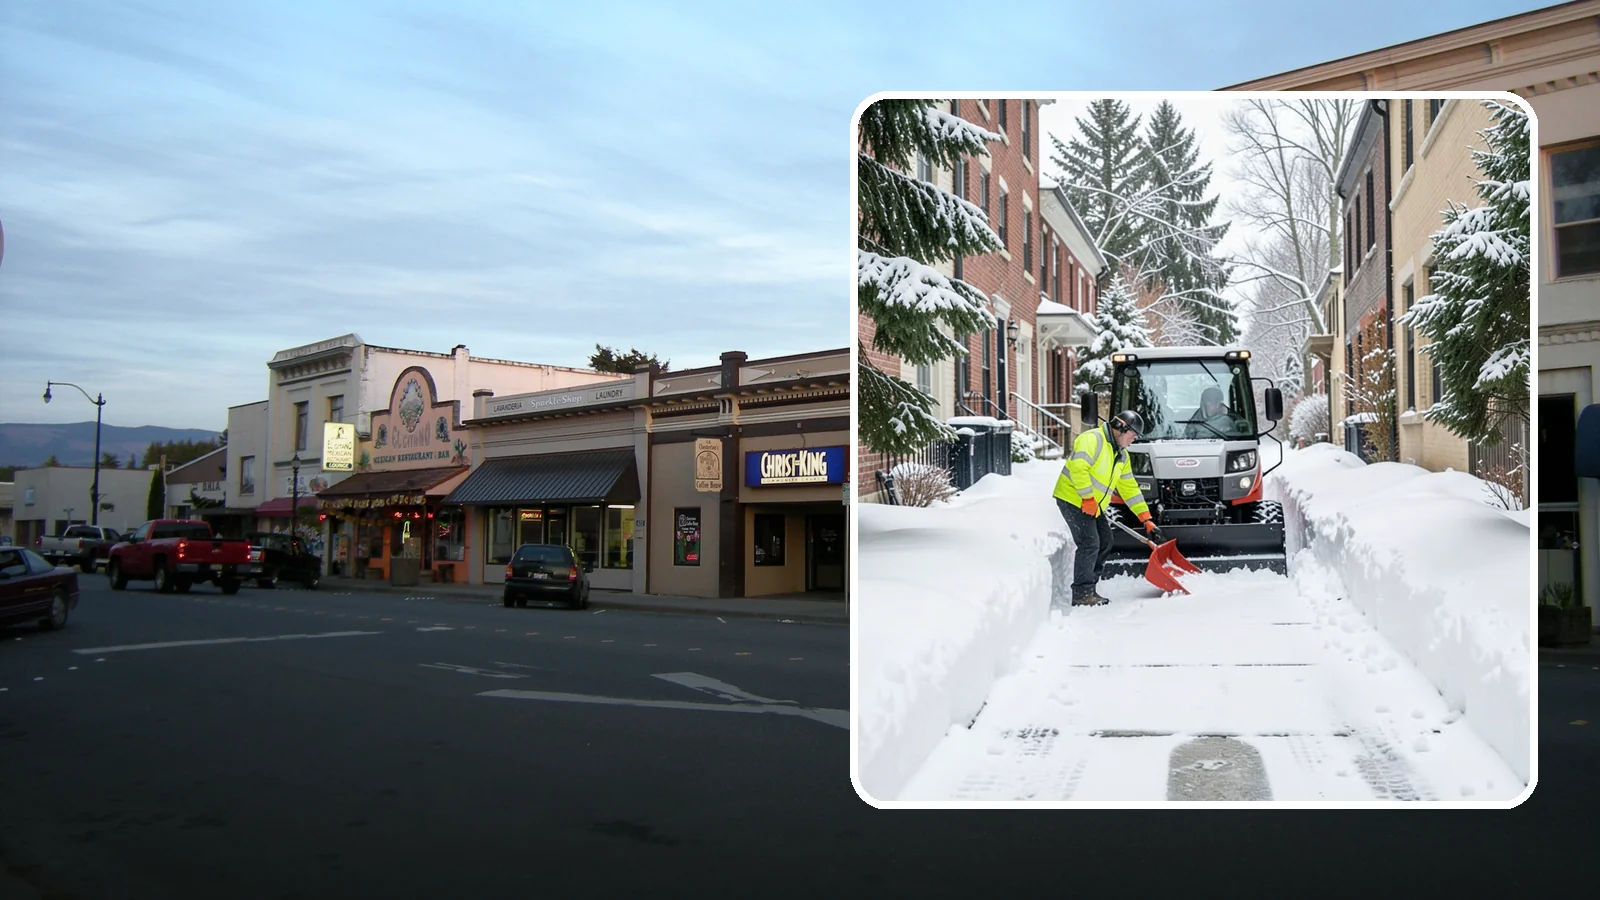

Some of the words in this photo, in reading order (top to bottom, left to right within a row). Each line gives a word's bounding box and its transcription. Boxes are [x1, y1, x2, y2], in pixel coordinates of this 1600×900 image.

[595, 389, 624, 400] LAUNDRY
[493, 402, 523, 412] LAVANDERIA
[531, 398, 561, 409] Sparkle
[562, 394, 582, 405] Shop
[374, 455, 396, 464] MEXICAN
[397, 451, 433, 462] RESTAURANT
[438, 450, 450, 459] BAR
[761, 452, 798, 478] CHRIST
[798, 450, 828, 476] KING
[710, 481, 722, 489] House
